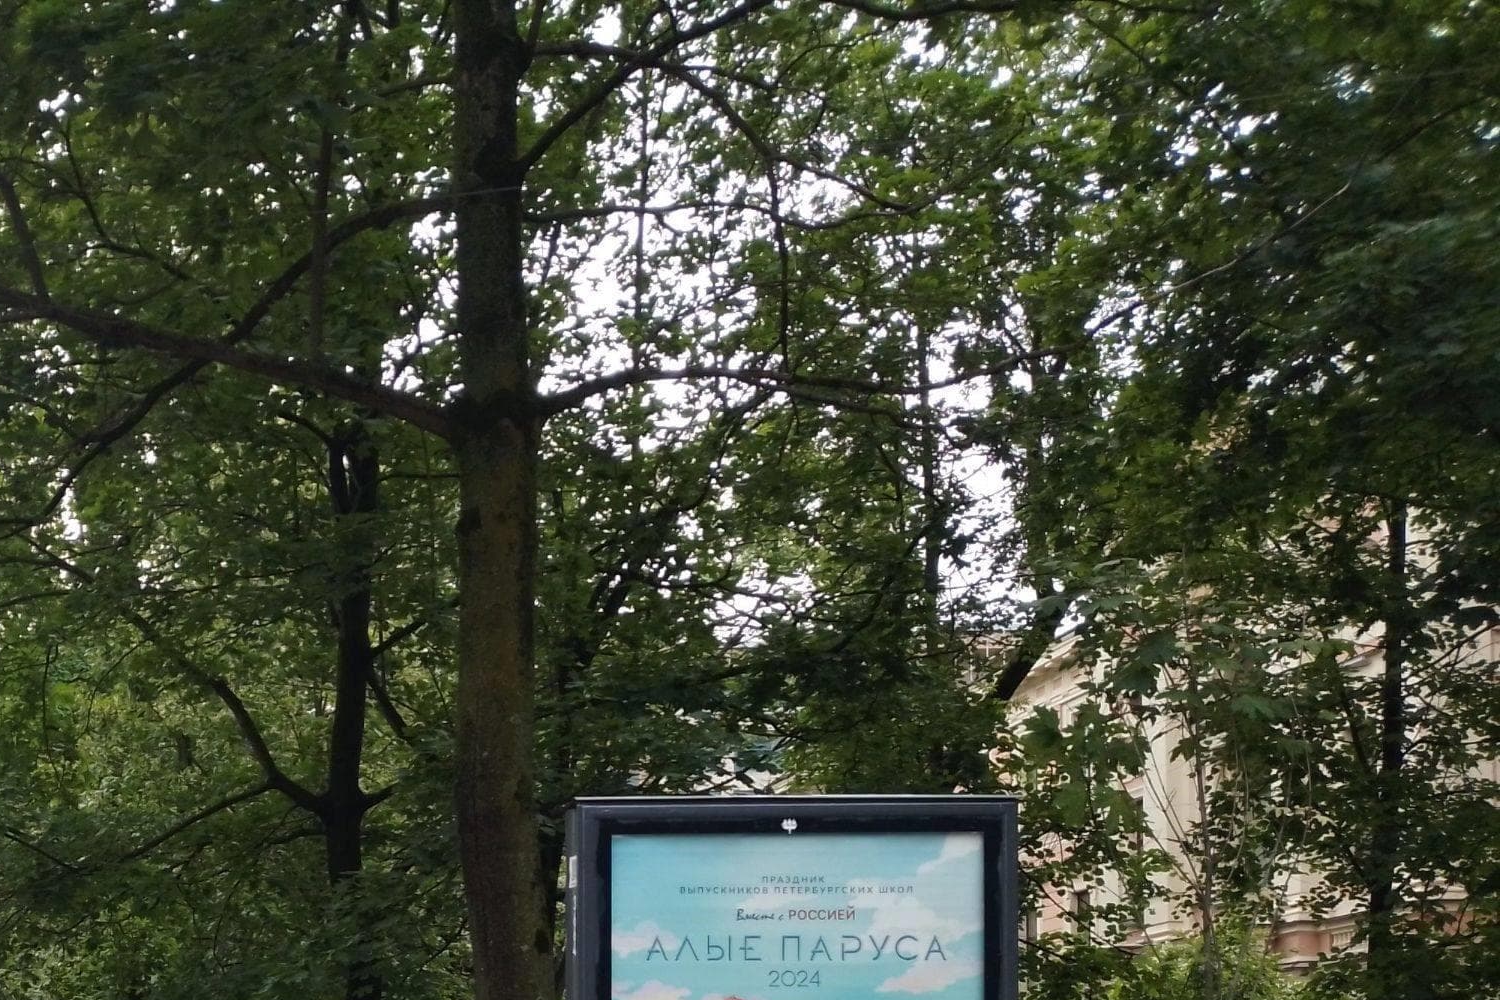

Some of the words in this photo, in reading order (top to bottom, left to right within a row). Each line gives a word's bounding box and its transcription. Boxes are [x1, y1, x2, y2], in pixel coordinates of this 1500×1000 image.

[762, 875, 825, 884] ПРАЗДНИК
[680, 886, 769, 895] ВЫПУСКНИКОВ
[774, 885, 873, 895] ПЕТЕРБУРГСКИХ
[879, 885, 914, 894] ШКОЛ
[788, 905, 856, 921] РОССИЕЙ
[646, 935, 762, 962] АЛЫЕ
[781, 935, 947, 962] ПАРУСА
[768, 970, 821, 988] 2024
